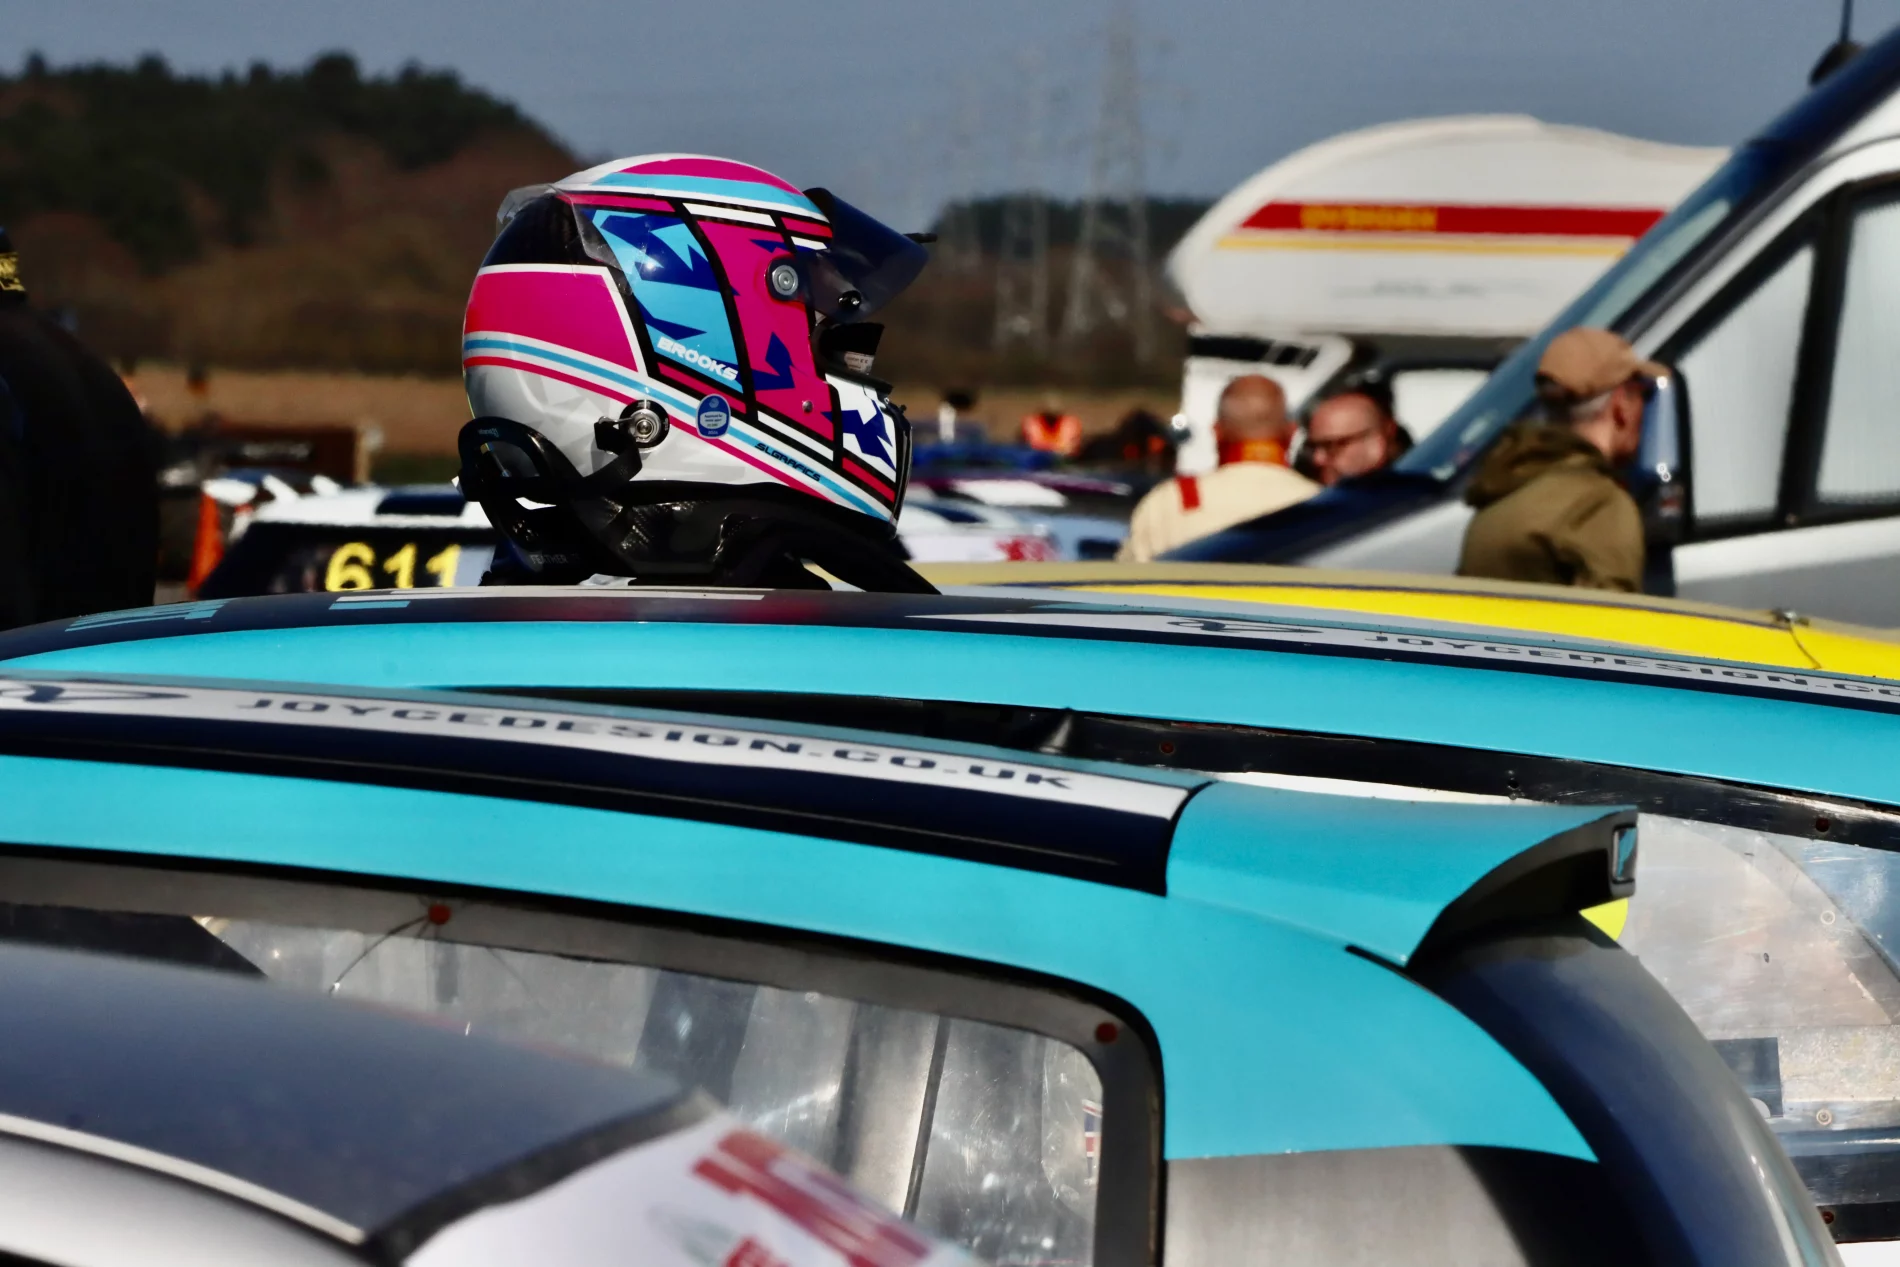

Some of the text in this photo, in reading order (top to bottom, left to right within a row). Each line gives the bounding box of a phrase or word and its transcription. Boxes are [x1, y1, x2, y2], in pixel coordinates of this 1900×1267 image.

[657, 336, 738, 381] BROOKS
[325, 542, 461, 592] 611
[239, 699, 1072, 790] JOYCEDESIGN.CO.UK
